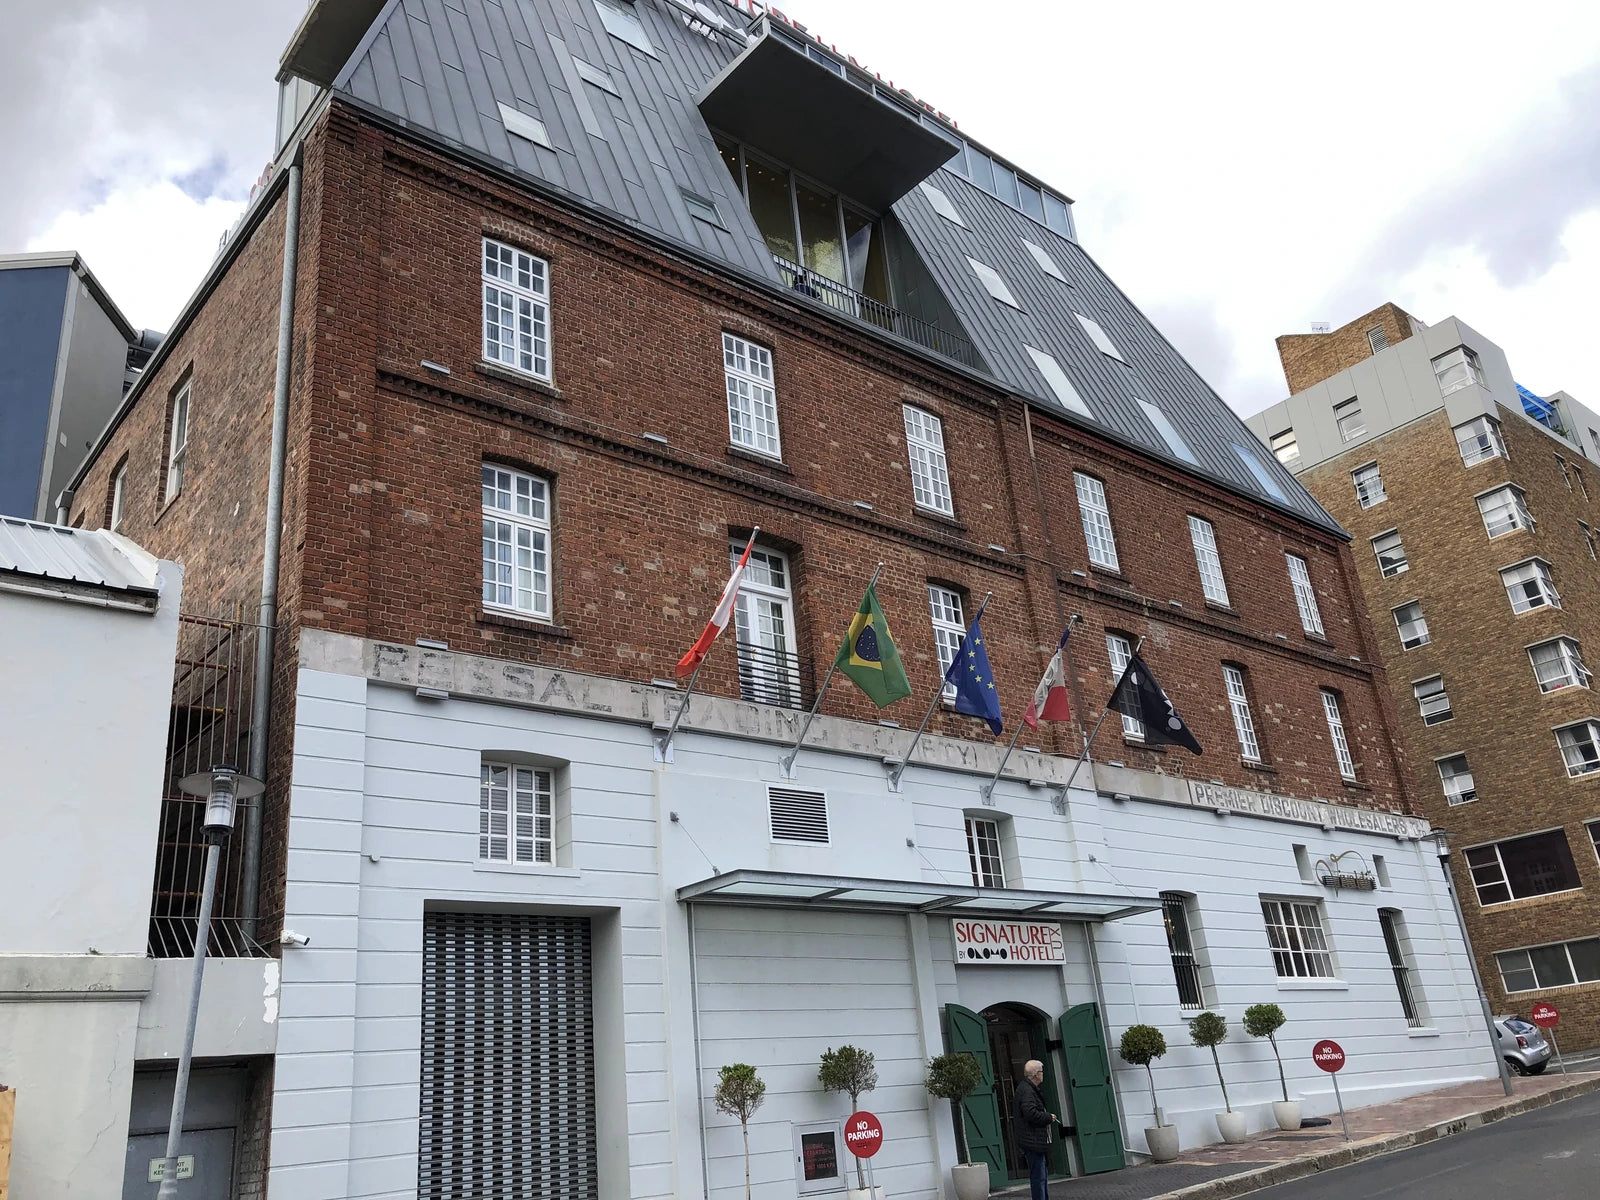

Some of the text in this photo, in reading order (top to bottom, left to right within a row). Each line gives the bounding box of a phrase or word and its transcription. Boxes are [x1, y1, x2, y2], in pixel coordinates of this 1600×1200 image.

[1259, 794, 1324, 822] DISCOUNT
[1327, 806, 1407, 835] WHOLESALERS
[955, 922, 1051, 945] SIGNATURE
[959, 950, 966, 959] BY
[1010, 945, 1053, 961] HOTEL
[1534, 1011, 1557, 1019] PARKING
[1315, 1053, 1343, 1061] PARKING
[857, 1120, 868, 1131] NO
[847, 1129, 880, 1142] PARKING
